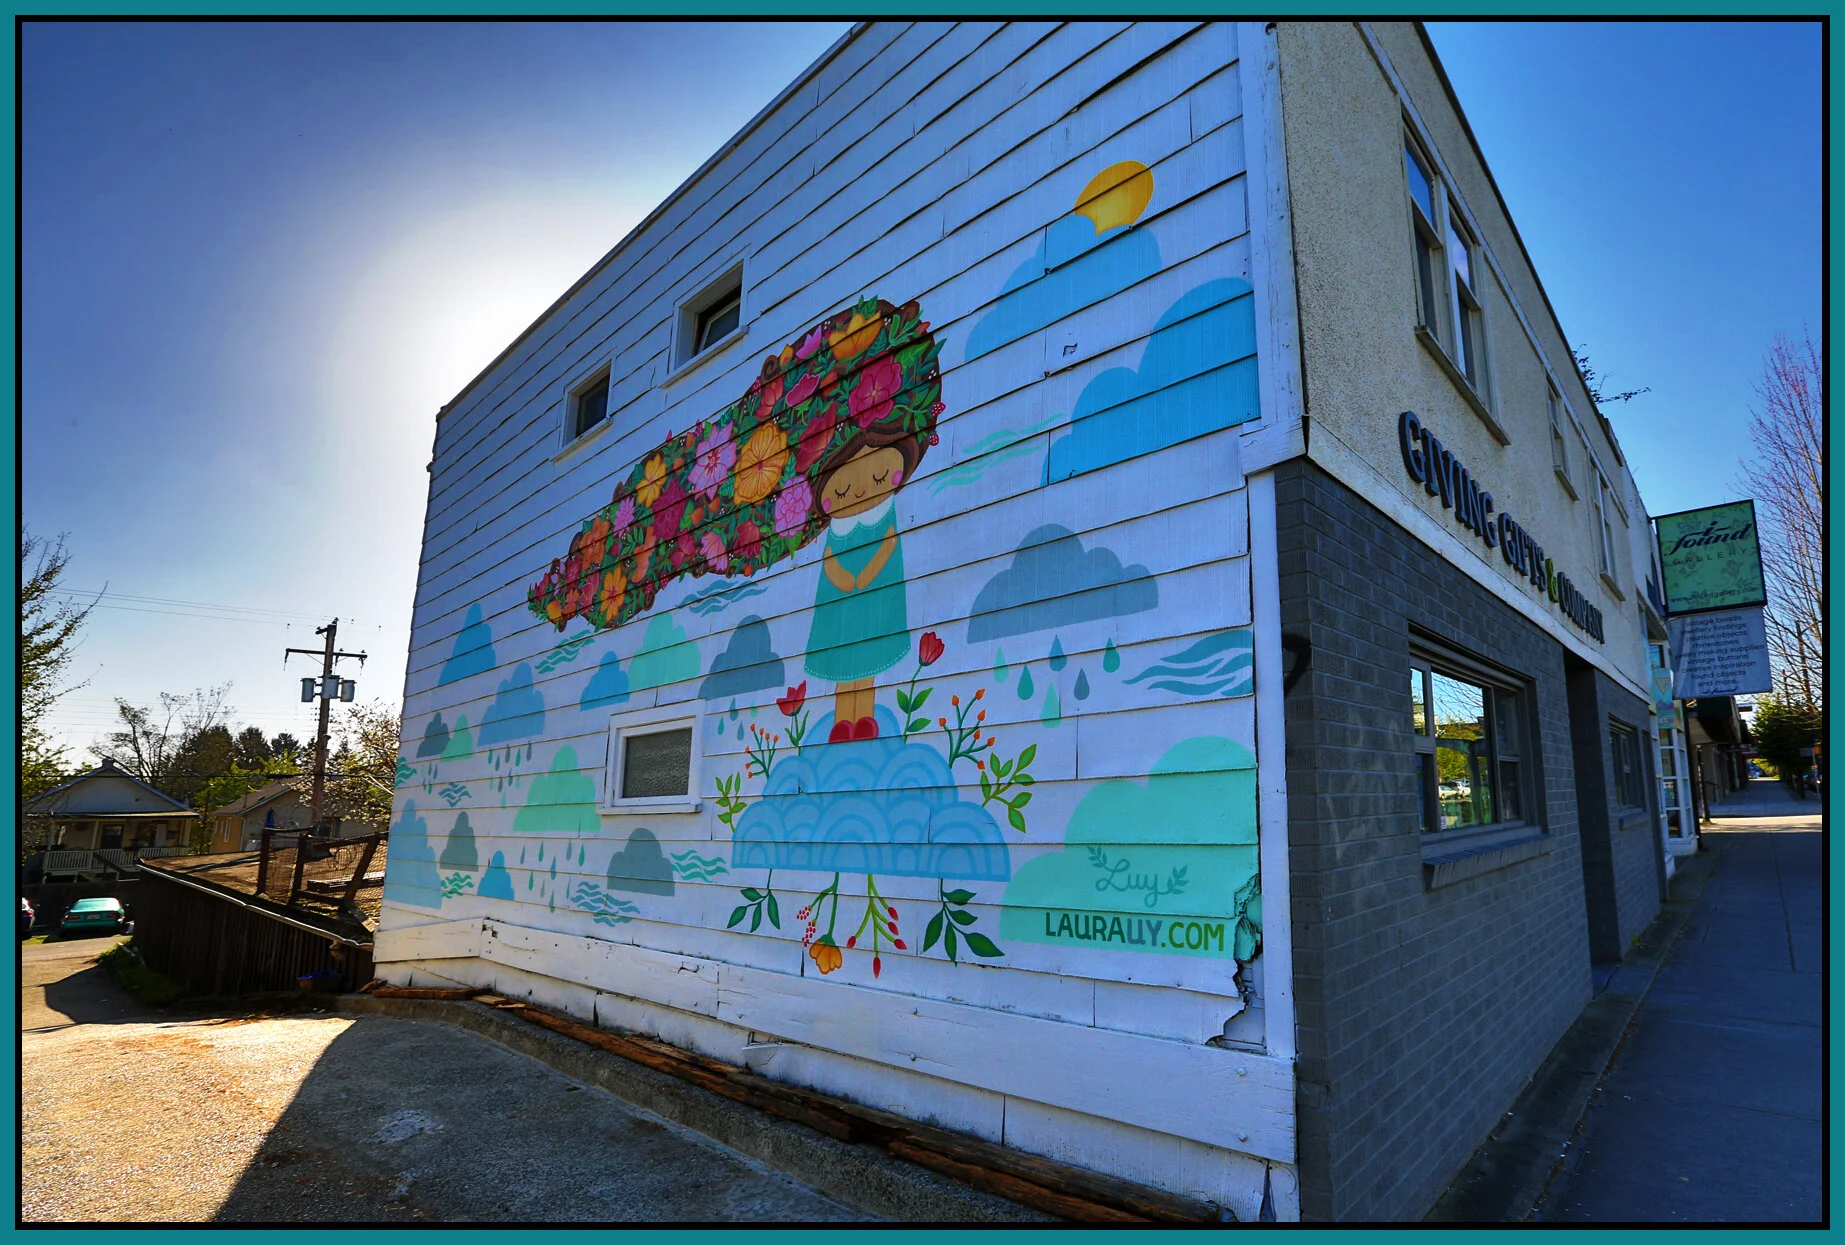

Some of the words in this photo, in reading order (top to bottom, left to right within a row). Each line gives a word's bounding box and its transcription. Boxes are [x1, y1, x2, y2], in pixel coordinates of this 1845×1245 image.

[1398, 411, 1498, 548] GIVING
[1498, 512, 1547, 592] GIFTS
[1557, 572, 1605, 644] COMPANY
[1663, 523, 1752, 556] found
[1672, 547, 1747, 566] GALLERY
[1716, 615, 1742, 623] beads
[1714, 622, 1747, 631] findings
[1716, 630, 1747, 638] objects
[1692, 640, 1739, 649] rhinestones
[1698, 648, 1728, 656] making
[1729, 643, 1765, 653] supplies
[1717, 653, 1749, 662] buttons
[1713, 660, 1756, 670] inspiration
[1691, 672, 1714, 680] found
[1716, 669, 1747, 678] objects
[1045, 912, 1225, 951] LAURAUY.COM
